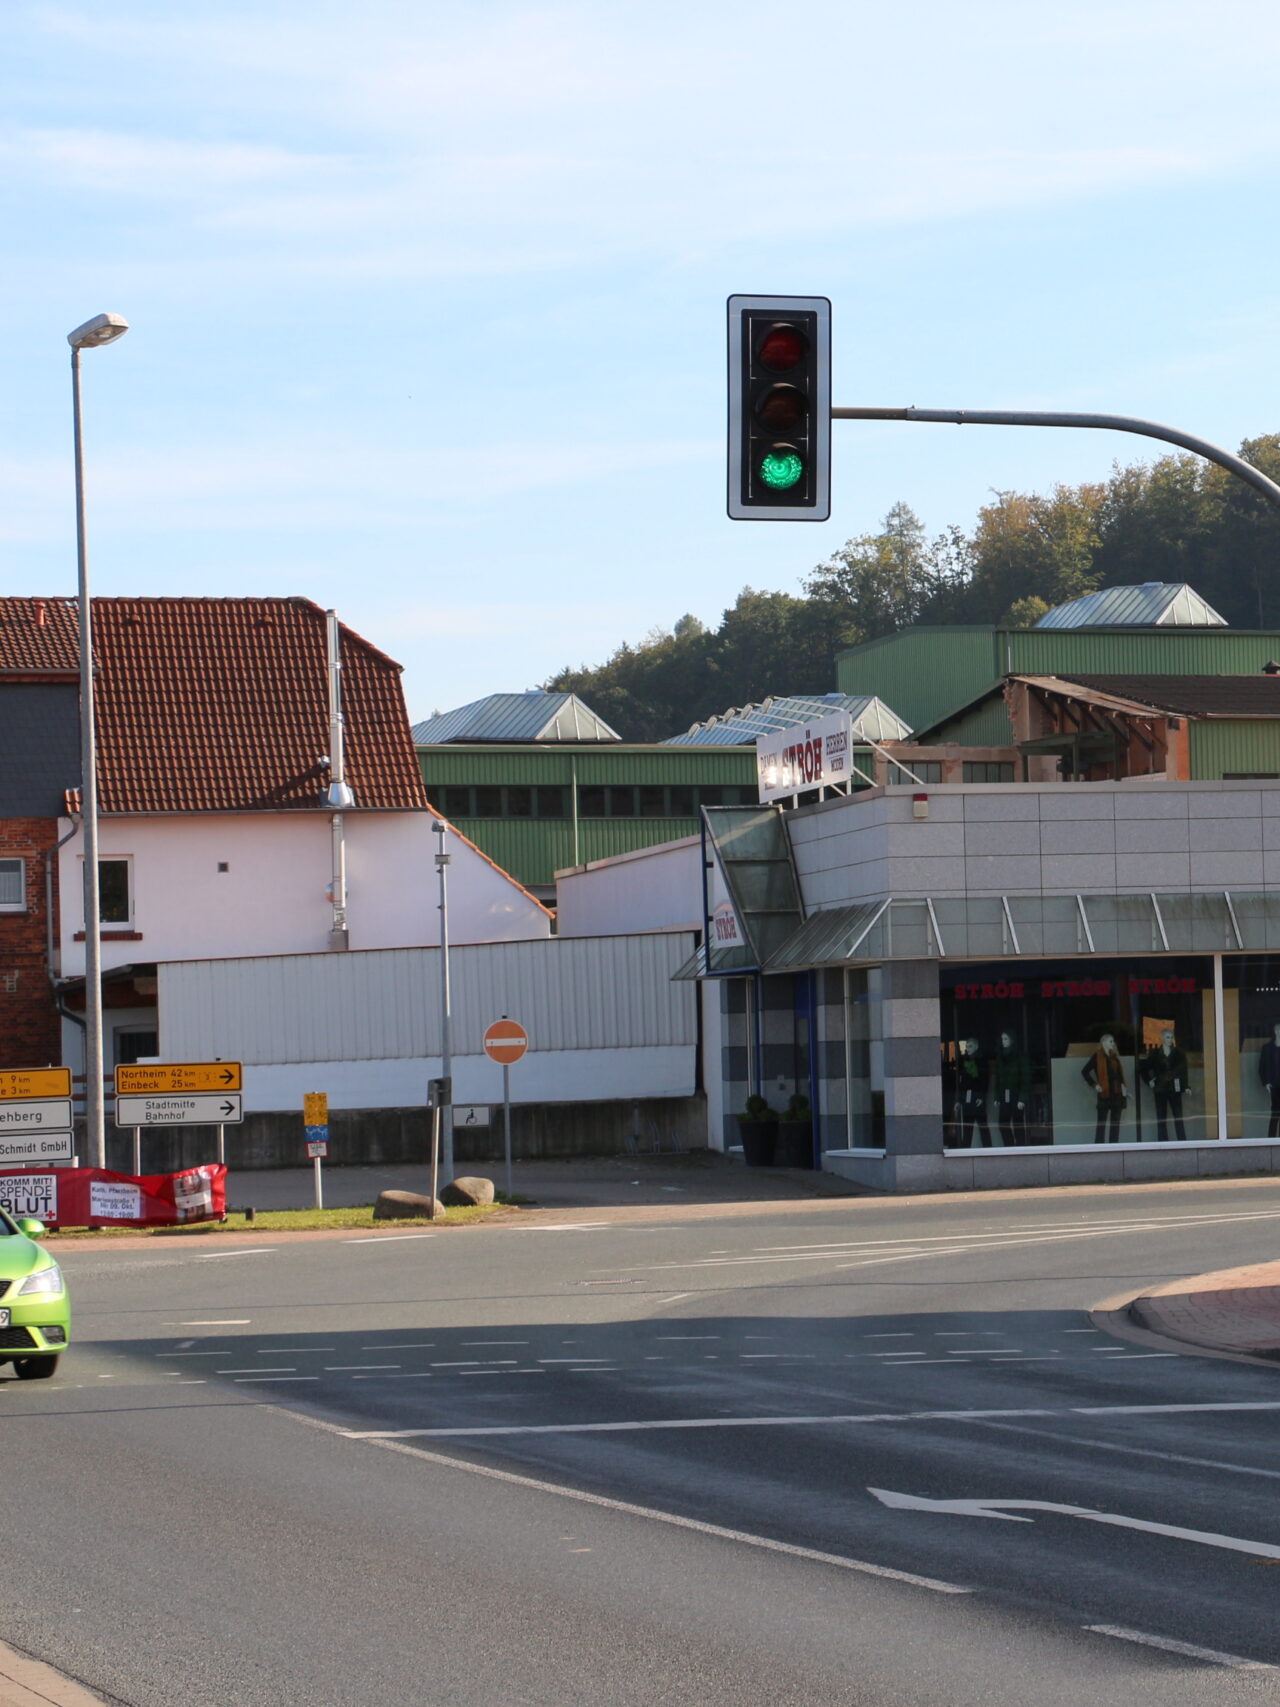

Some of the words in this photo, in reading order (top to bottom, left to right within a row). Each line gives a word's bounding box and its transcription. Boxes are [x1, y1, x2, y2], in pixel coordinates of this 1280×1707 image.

[715, 911, 738, 941] STRÖH
[954, 979, 1025, 1000] STRÖH
[1041, 978, 1111, 998] STRÖH
[1127, 976, 1197, 995] STRÖH
[10, 1075, 17, 1083] 9
[121, 1069, 167, 1079] Northeim
[170, 1069, 183, 1078] 42
[184, 1069, 196, 1077] km
[121, 1080, 160, 1090] Einbeck
[171, 1080, 183, 1088] 25
[184, 1080, 196, 1088] km
[11, 1087, 17, 1095] 3
[145, 1101, 196, 1110] Stadtmitte
[0, 1112, 43, 1123] ehberg
[145, 1111, 186, 1121] Bahnhof
[0, 1143, 37, 1155] Schmidt
[41, 1141, 67, 1152] GmbH
[0, 1178, 30, 1186] KOMM
[33, 1177, 53, 1186] MIT!
[0, 1185, 52, 1199] SPENDE
[0, 1197, 52, 1215] BLUT
